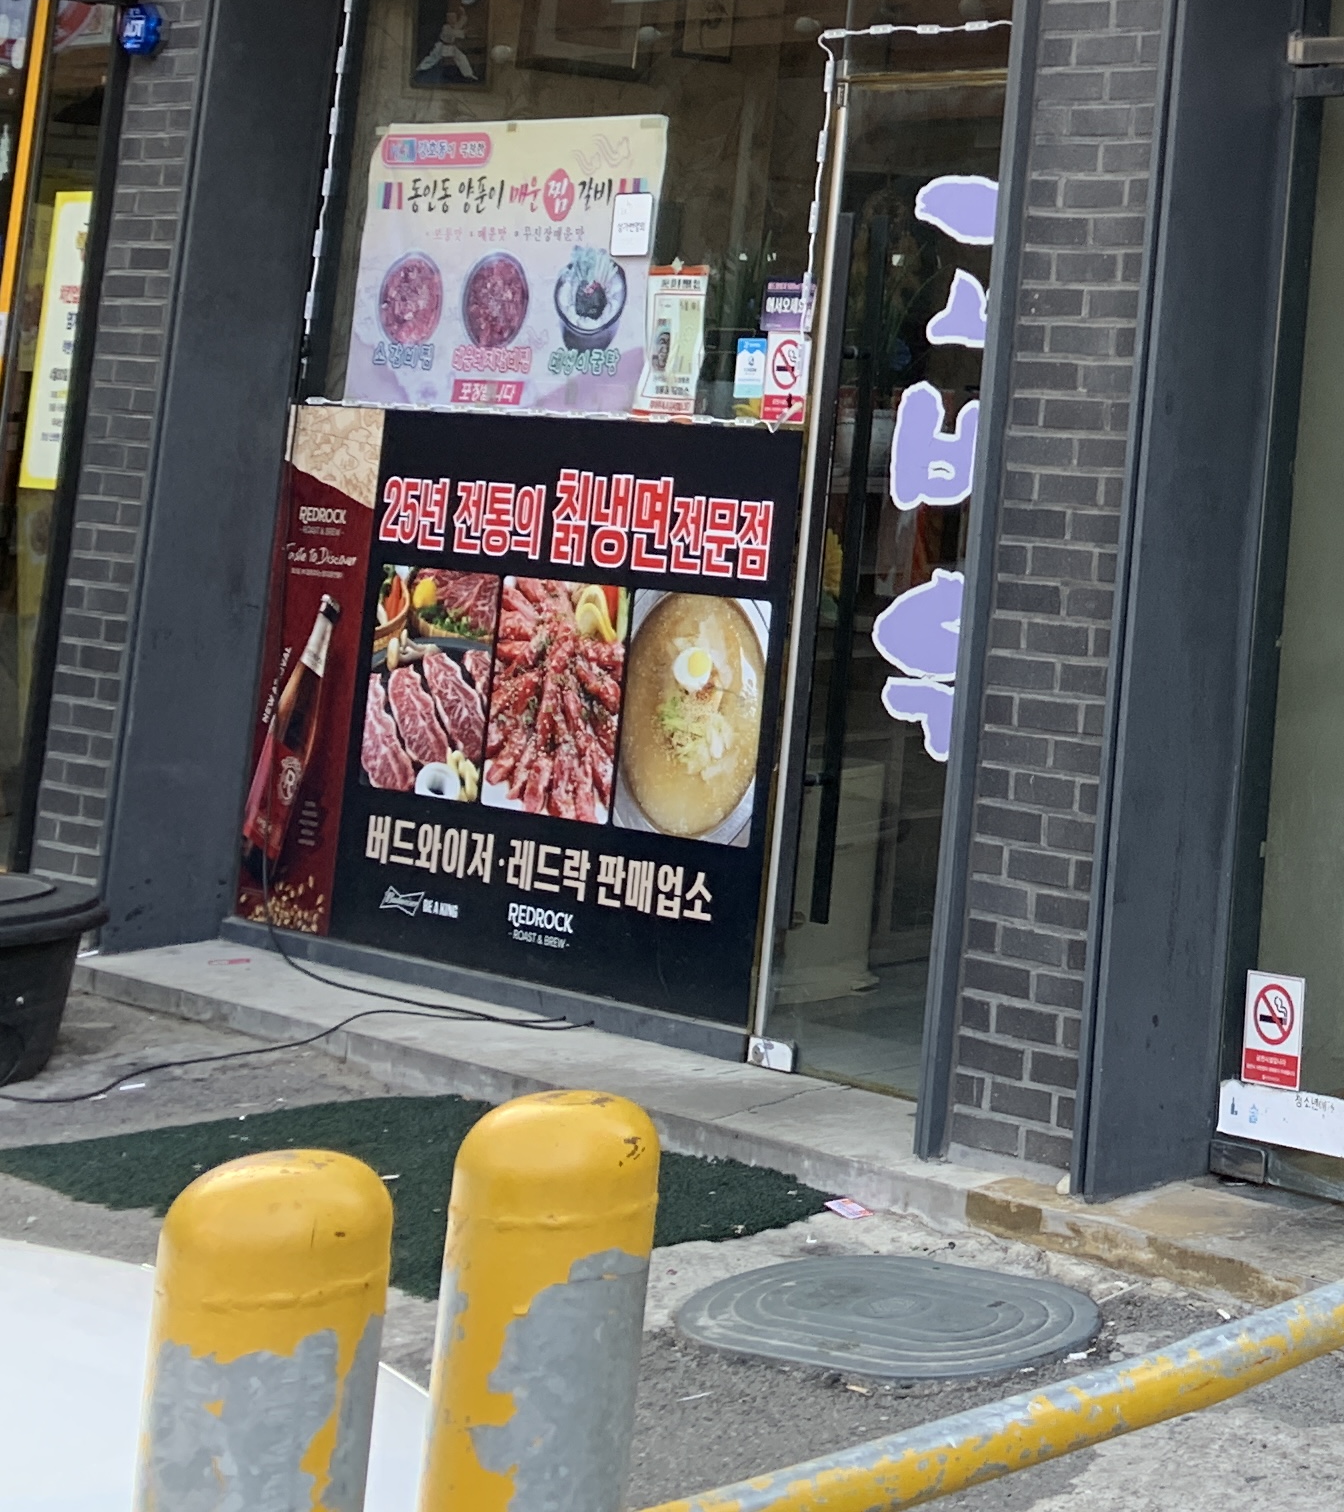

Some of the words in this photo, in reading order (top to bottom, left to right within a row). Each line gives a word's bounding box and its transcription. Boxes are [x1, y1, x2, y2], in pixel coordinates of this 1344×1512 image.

[407, 176, 452, 213] 동인동
[457, 176, 505, 214] 양푼이
[510, 176, 542, 213] 매운
[578, 177, 613, 212] 갈비
[299, 505, 347, 524] REDROCK
[379, 475, 451, 550] 25년
[453, 480, 547, 559] 전통의
[596, 853, 715, 922] 판매업소
[507, 902, 574, 934] REDROCK
